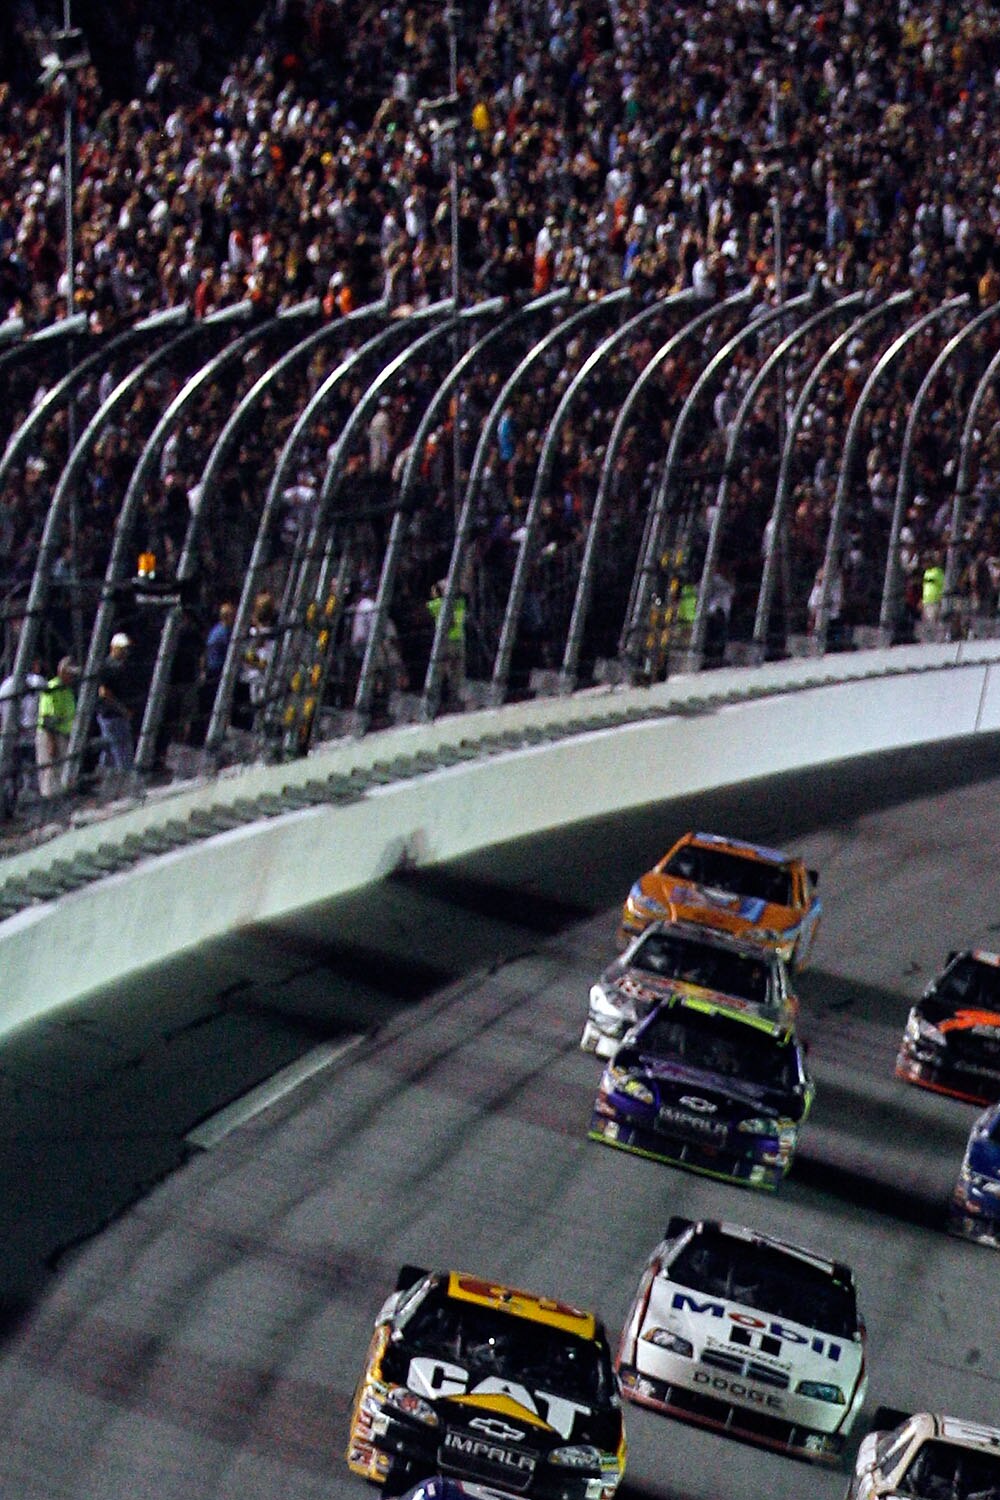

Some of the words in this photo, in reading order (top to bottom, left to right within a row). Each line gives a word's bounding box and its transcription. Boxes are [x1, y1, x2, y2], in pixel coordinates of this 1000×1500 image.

[671, 1293, 842, 1363] Mobil
[407, 1357, 592, 1440] CAT
[692, 1370, 782, 1410] DODGE
[444, 1433, 536, 1472] IMPALA
